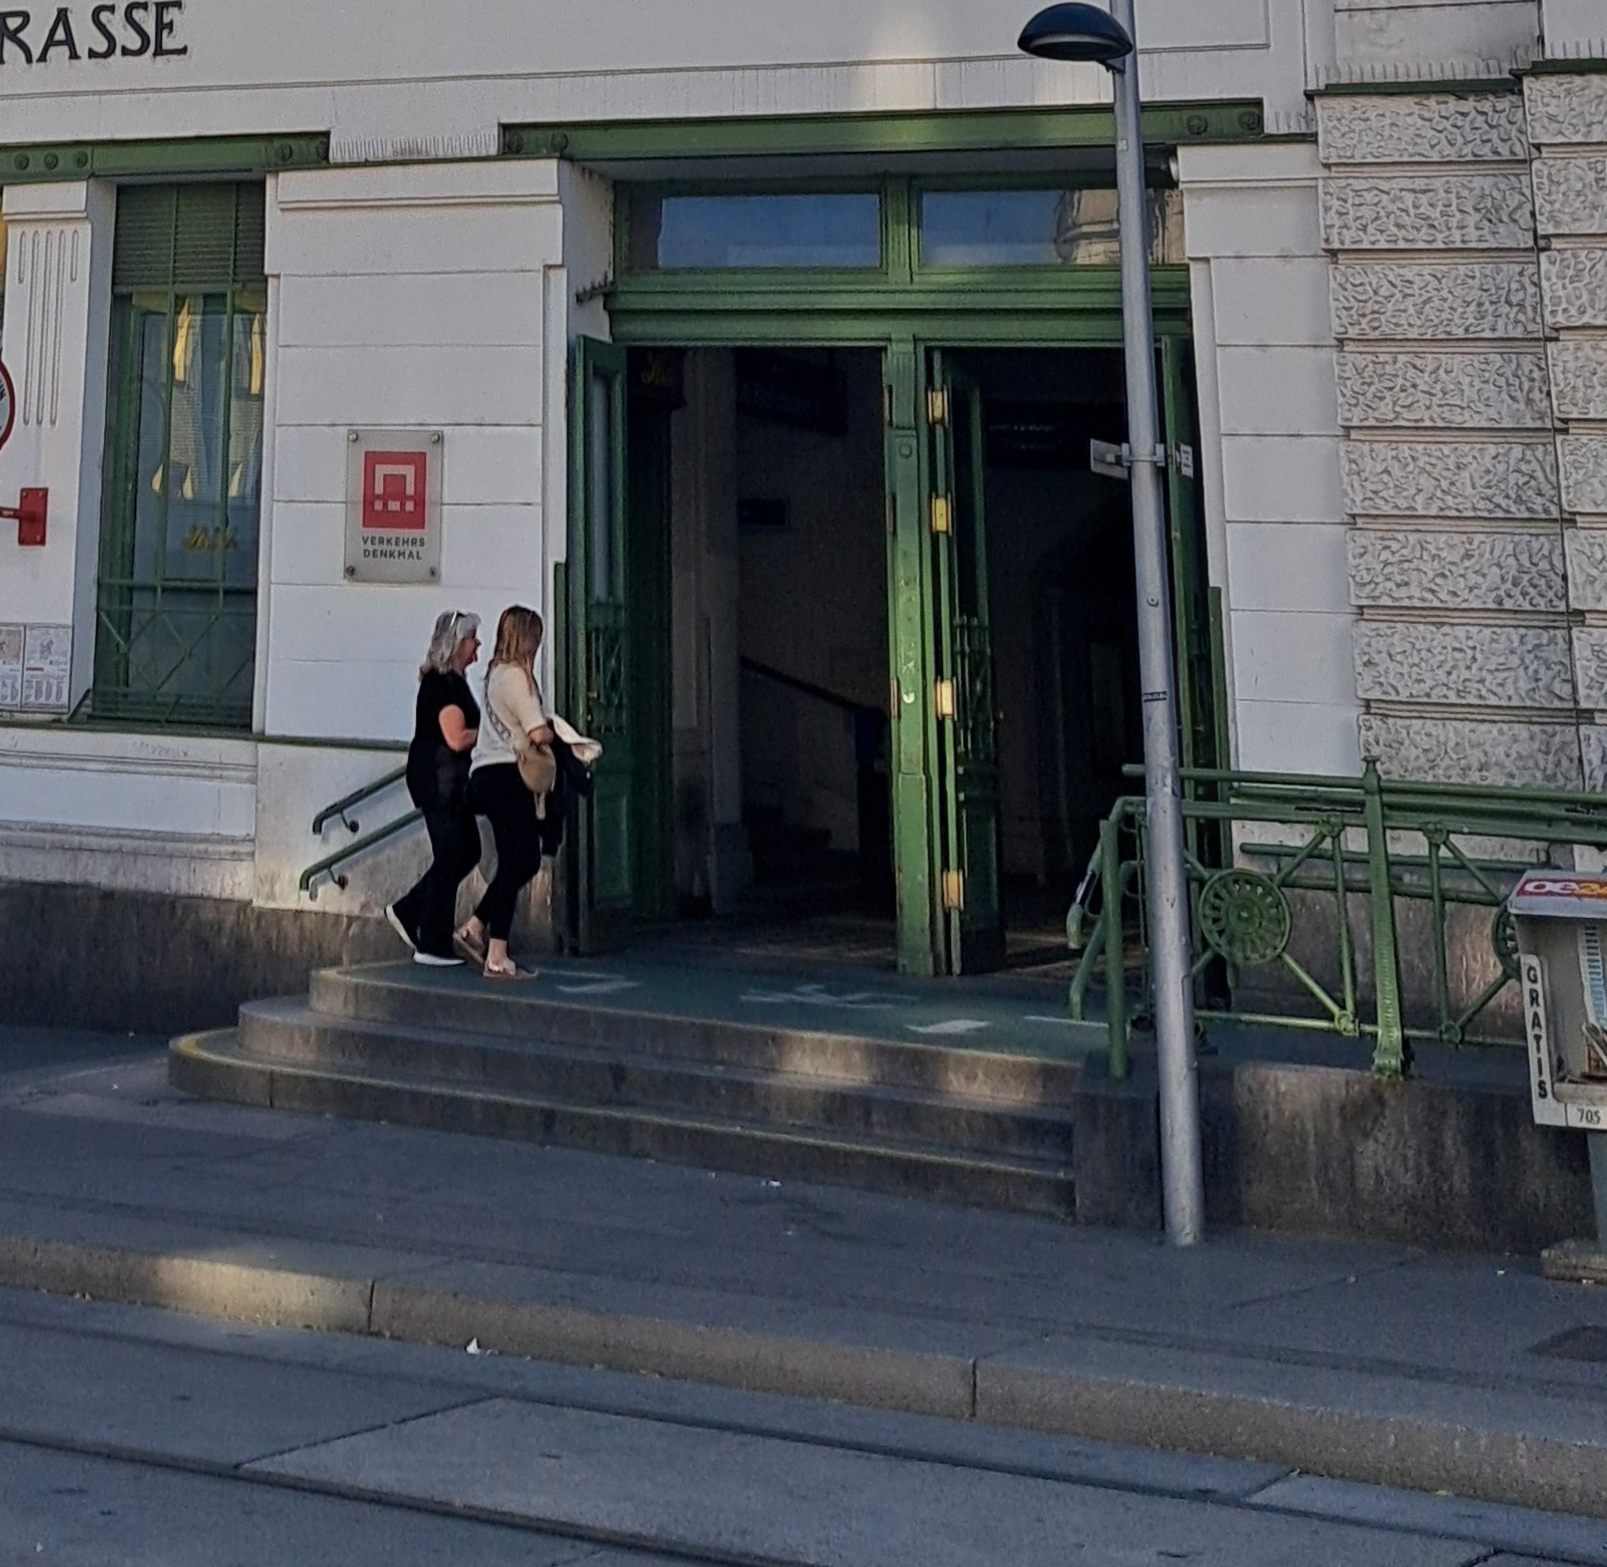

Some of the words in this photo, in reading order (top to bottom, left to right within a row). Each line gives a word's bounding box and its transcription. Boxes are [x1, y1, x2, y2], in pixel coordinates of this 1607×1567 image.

[362, 535, 425, 547] VERKEHRS
[363, 549, 422, 560] DENKMAL
[1526, 965, 1548, 1100] GRATIS
